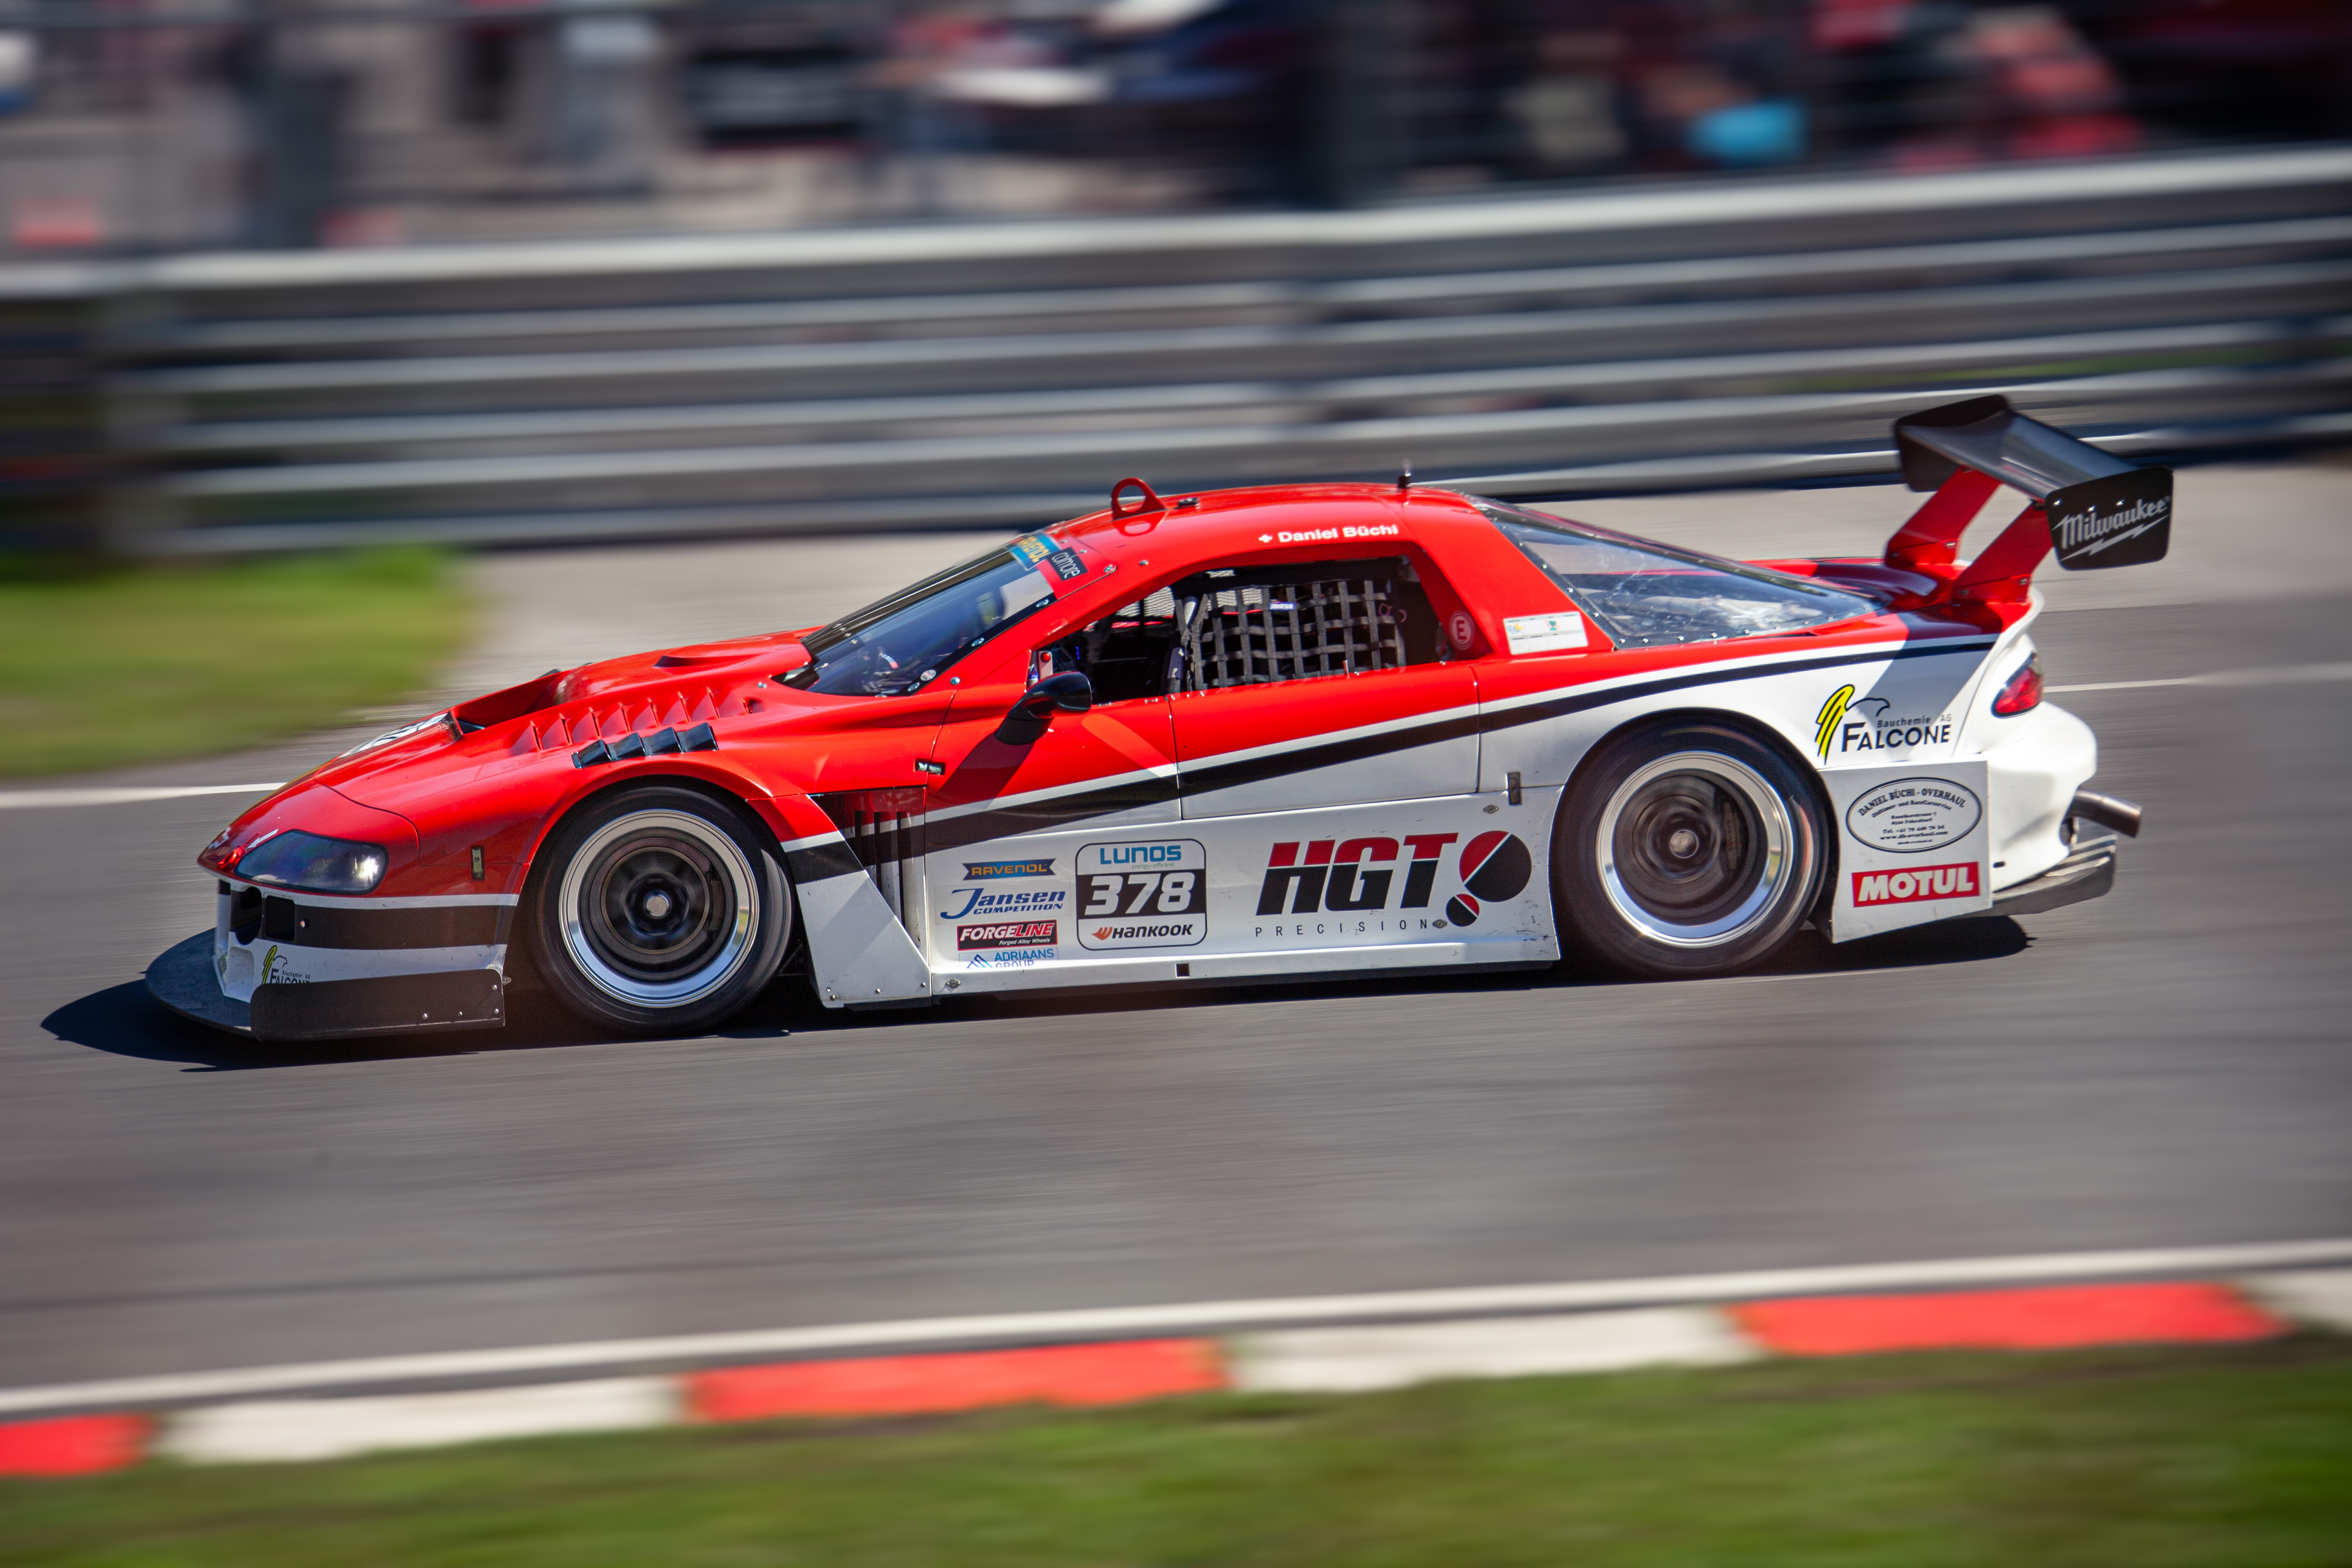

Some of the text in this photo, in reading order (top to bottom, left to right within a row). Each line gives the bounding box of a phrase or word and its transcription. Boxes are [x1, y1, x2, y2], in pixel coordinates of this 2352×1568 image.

[1278, 524, 1399, 543] Daniel Büchi
[2052, 499, 2168, 549] Milwaukee
[1456, 620, 1467, 640] E
[1877, 714, 1953, 728] Bauchemie AG
[1841, 722, 1951, 752] FALCONE
[1858, 794, 1888, 816] DANIEL
[1888, 789, 1915, 801] BÜCHI
[1921, 788, 1967, 808] OVERHAUL
[971, 864, 1047, 876] RAVENOL
[1256, 832, 1459, 916] HGT
[1085, 872, 1195, 915] 378
[1858, 866, 1974, 902] MOTUL
[940, 888, 1066, 919] Jansen
[973, 903, 1063, 914] COMPETITION
[960, 922, 1055, 941] FORGELINE
[1255, 919, 1428, 937] PRECISION
[994, 948, 1054, 962] ADRIAANS
